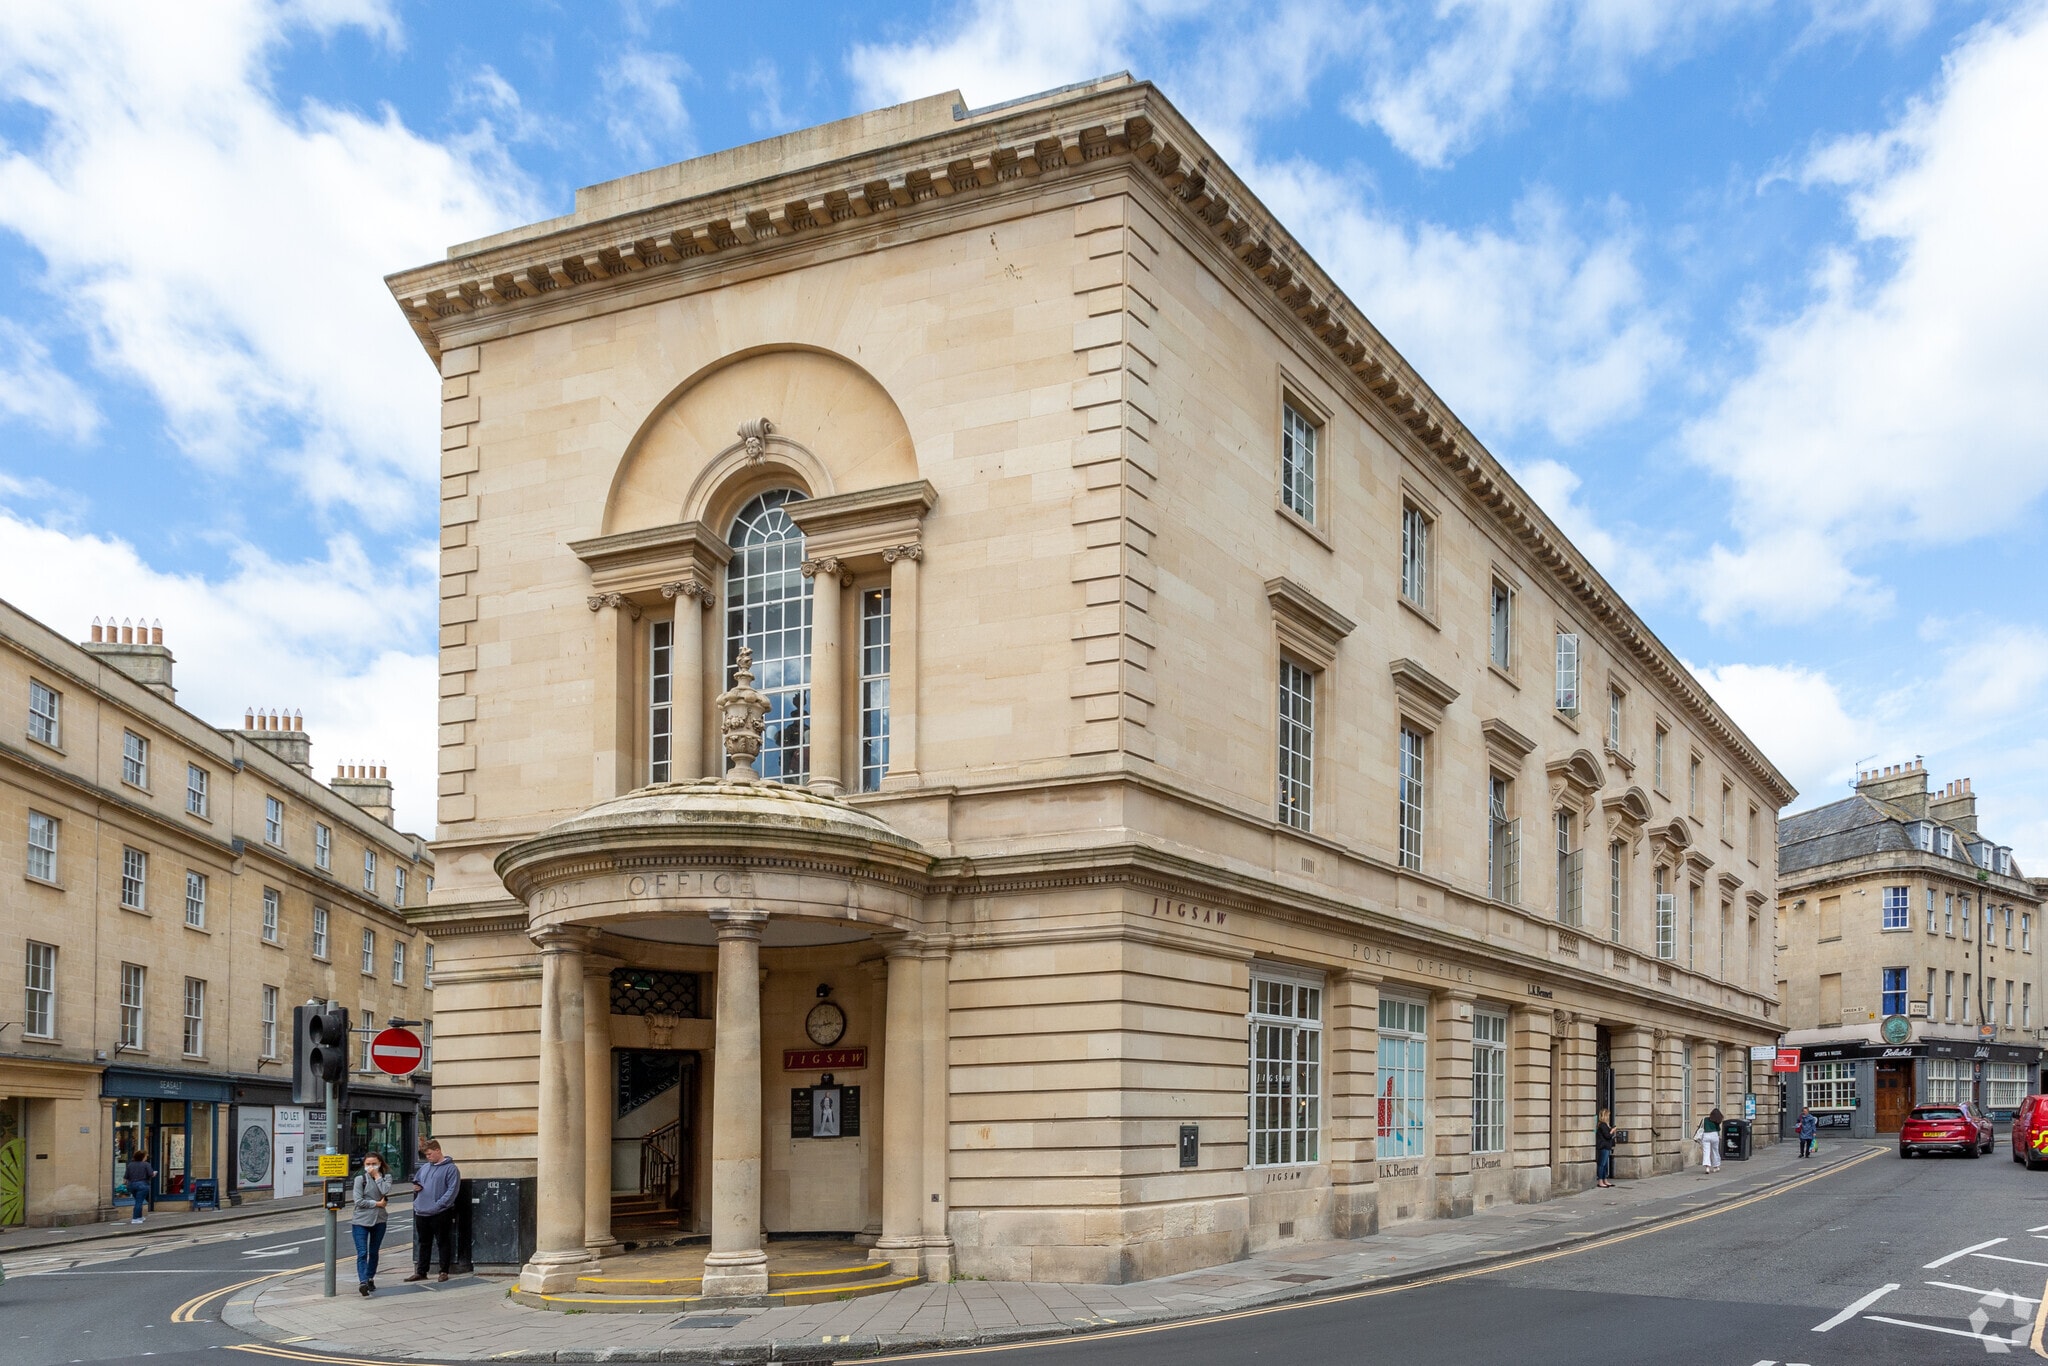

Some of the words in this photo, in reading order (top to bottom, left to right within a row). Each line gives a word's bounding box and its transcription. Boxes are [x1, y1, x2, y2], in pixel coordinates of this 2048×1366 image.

[539, 882, 585, 912] POST
[629, 874, 753, 895] OFFICE
[1152, 898, 1227, 925] JIGSAW
[1353, 944, 1392, 965] POST
[1417, 959, 1473, 983] OFFICE
[788, 1053, 862, 1067] JIGSAW
[160, 1080, 183, 1090] SEASALT
[280, 1111, 289, 1120] TO
[290, 1111, 300, 1120] LET
[1471, 1157, 1501, 1170] L.K.Bennett
[1266, 1171, 1302, 1184] JIGSAW
[1379, 1164, 1419, 1178] L.K.Bennett
